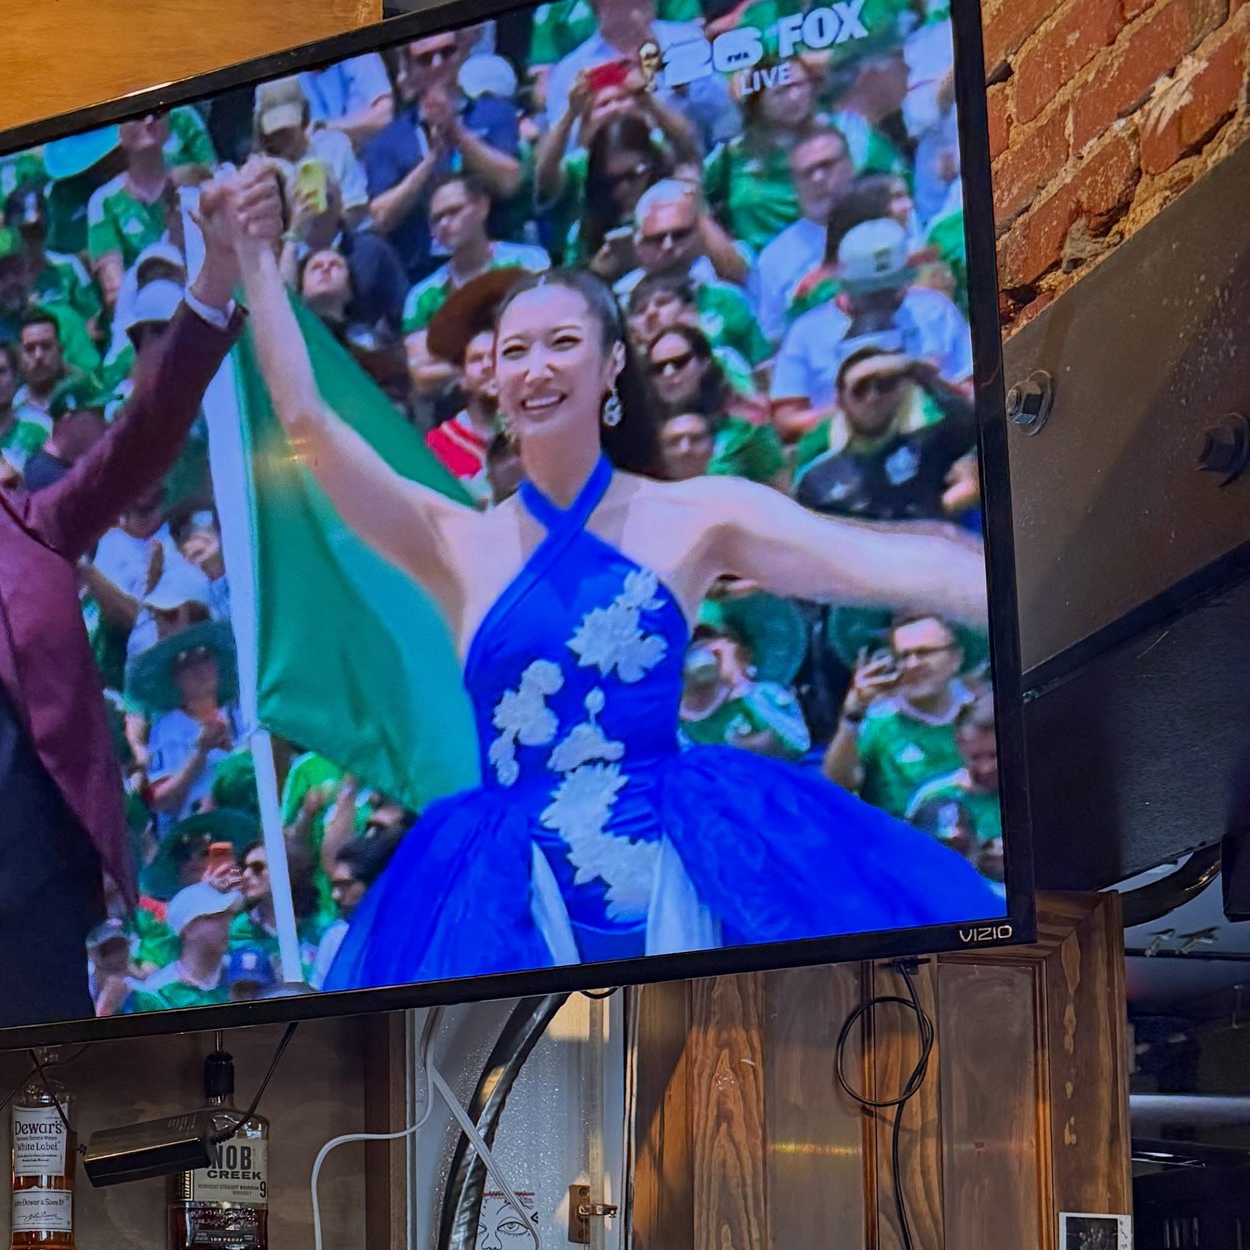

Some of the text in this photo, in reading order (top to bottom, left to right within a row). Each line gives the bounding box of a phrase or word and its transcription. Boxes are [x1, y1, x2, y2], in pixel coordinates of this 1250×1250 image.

[778, 0, 868, 57] FOX
[740, 62, 791, 96] LIVE
[959, 925, 1013, 942] VIZIO
[15, 1121, 63, 1135] Dewar's
[211, 1145, 251, 1170] NOB
[207, 1170, 261, 1180] CREEK
[260, 1181, 267, 1198] 9
